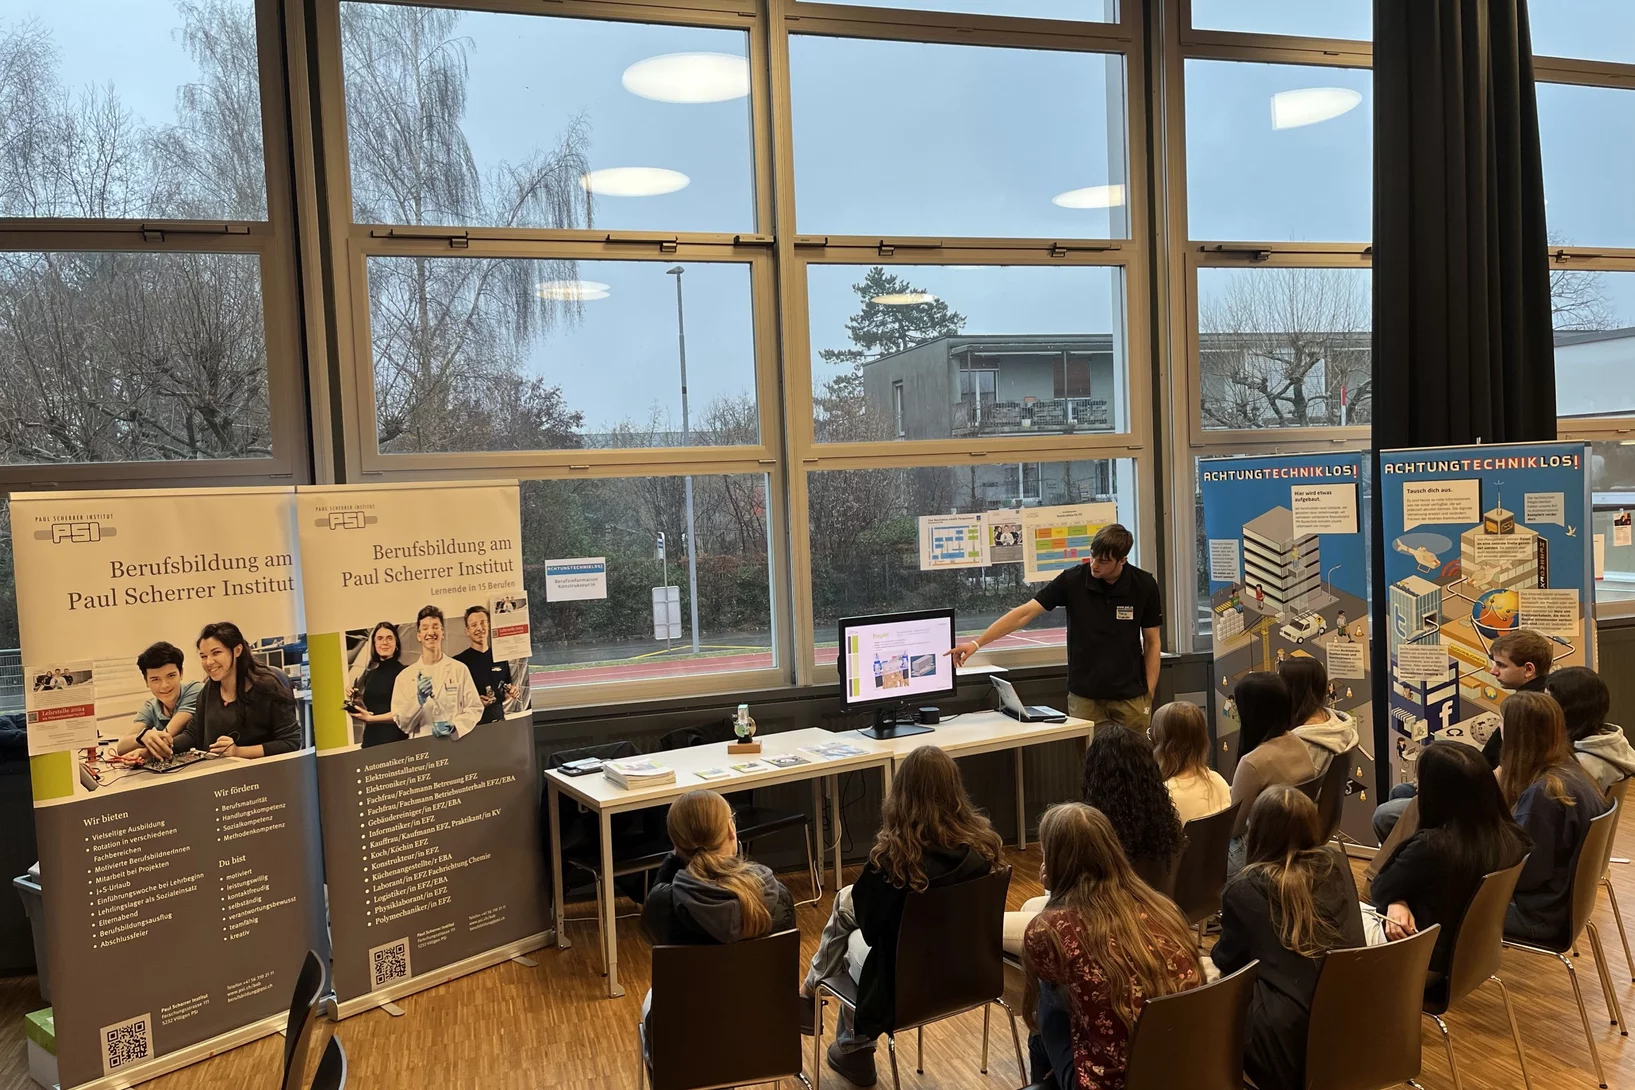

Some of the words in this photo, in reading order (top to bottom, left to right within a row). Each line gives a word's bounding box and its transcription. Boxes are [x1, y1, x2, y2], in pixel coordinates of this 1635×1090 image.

[328, 511, 366, 530] PSI
[52, 522, 101, 544] PSI
[373, 538, 485, 560] Berufsbildung
[490, 538, 512, 550] am
[110, 552, 258, 578] Berufsbildung
[264, 552, 293, 568] am
[342, 568, 379, 587] Paul
[384, 562, 453, 582] Scherrer
[458, 559, 514, 576] Institut
[68, 588, 117, 610] Paul
[125, 582, 215, 606] Scherrer
[222, 576, 295, 597] Institut
[430, 585, 467, 596] Lernende
[468, 584, 477, 593] in
[478, 583, 486, 591] 15
[488, 580, 515, 590] Berufen
[364, 756, 414, 772] Automatiker/in
[416, 752, 430, 760] EFZ
[365, 762, 435, 783] Elektroinstallateur/in
[436, 759, 449, 767] EFZ
[214, 789, 228, 797] Wir
[230, 784, 260, 794] fördern
[366, 777, 416, 793] Elektroniker/in
[417, 773, 431, 782] EFZ
[367, 785, 432, 804] Fachfrau/Fachmann
[434, 778, 464, 789] Betreuung
[465, 773, 478, 782] EFZ
[222, 797, 268, 811] Berufsmaturität
[368, 796, 433, 815] Fachfrau/Fachmann
[434, 782, 486, 799] Betriebsunterhalt
[487, 775, 516, 786] EFZ/EBA
[84, 817, 100, 826] Wir
[102, 812, 128, 822] bieten
[222, 803, 286, 821] Handlungskompetenz
[368, 806, 431, 826] Gebäudereiniger/in
[433, 798, 462, 810] EFZ/EBA
[92, 829, 126, 840] Vielseitige
[128, 821, 165, 833] Ausbildung
[223, 816, 273, 831] Sozialkompetenz
[224, 823, 285, 841] Methodenkompetenz
[369, 820, 420, 837] Informatiker/in
[422, 815, 435, 824] EFZ
[370, 828, 435, 848] Kauffrau/Kaufmann
[436, 822, 451, 831] EFZ,
[452, 812, 491, 827] Praktikant/in
[93, 841, 120, 851] Rotation
[130, 829, 177, 843] verschiedenen
[371, 843, 414, 859] Koch/Köchin
[414, 838, 428, 847] EFZ
[94, 847, 142, 862] Fachbereichen
[232, 855, 246, 864] bist
[372, 851, 425, 870] Konstrukteur/in
[426, 846, 439, 855] EFZ
[95, 861, 127, 873] Motivierte
[95, 872, 125, 883] Mitarbeit
[139, 862, 170, 873] Projekten
[226, 869, 252, 880] motiviert
[372, 858, 438, 881] Küchenangestellte/r
[438, 854, 452, 862] EBA
[373, 876, 413, 892] Laborant/in
[414, 871, 427, 880] EFZ
[428, 860, 468, 876] Fachrichtung
[469, 853, 491, 865] Chemie
[97, 886, 157, 905] Einführungswoche
[170, 873, 204, 886] Lehrbeginn
[227, 875, 268, 890] leistungswillig
[227, 885, 269, 900] kontaktfreudig
[374, 886, 416, 903] Logistiker/in
[417, 876, 448, 890] EFZ/EBA
[98, 900, 144, 916] Lehrlingslager
[156, 885, 197, 900] Sozialeinsatz
[228, 897, 262, 910] selbständig
[229, 897, 296, 920] verantwortungsbewusst
[375, 892, 433, 914] Physiklaborant/in
[434, 886, 448, 896] EFZ
[375, 901, 437, 925] Polymechaniker/in
[438, 896, 452, 905] EFZ
[99, 910, 139, 926] Elternabend
[100, 913, 172, 937] Berufsbildungsausflug
[229, 917, 259, 930] teamfähig
[100, 930, 149, 948] Abschlussfeier
[230, 930, 250, 939] kreativ
[172, 1000, 191, 1009] Scherrer
[192, 994, 208, 1002] Institut
